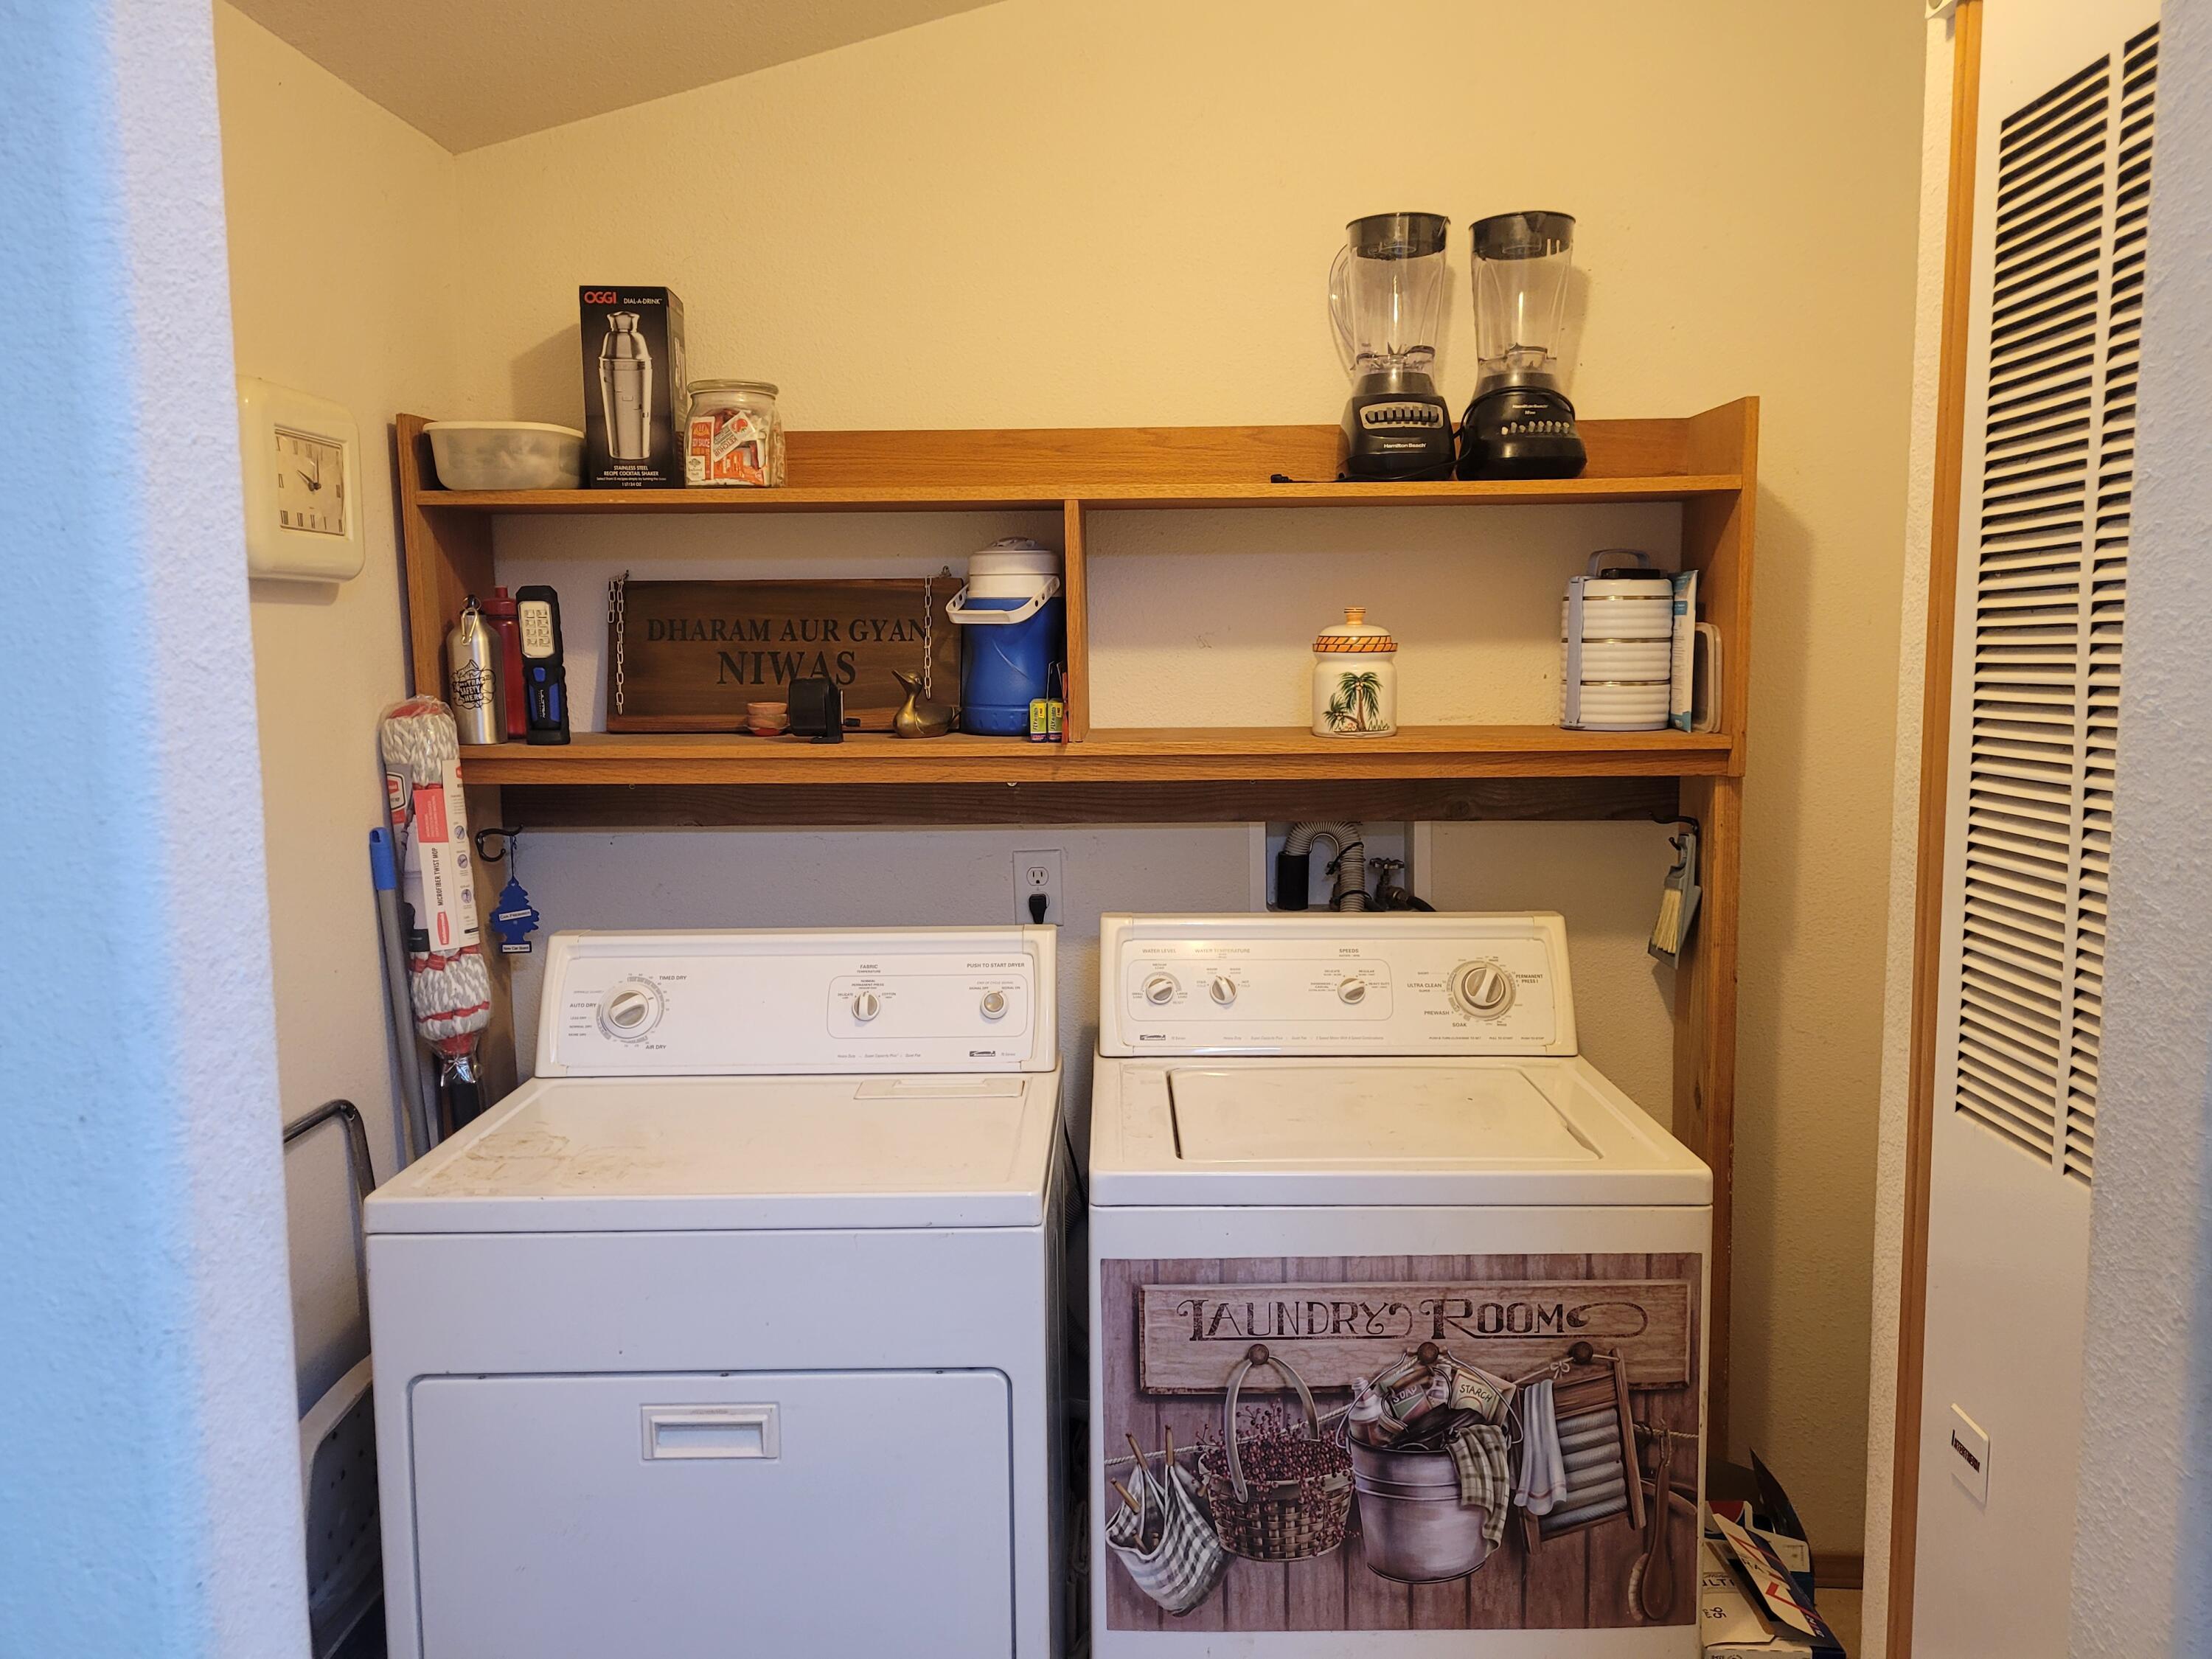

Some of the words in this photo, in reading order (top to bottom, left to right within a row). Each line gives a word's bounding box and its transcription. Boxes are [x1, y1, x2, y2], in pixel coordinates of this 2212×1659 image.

[584, 291, 616, 304] OGGI
[647, 619, 771, 641] DHARAM
[779, 619, 840, 641] AUR
[849, 619, 927, 641] GYAN
[717, 650, 856, 685] NIWAS
[465, 693, 484, 702] HERO
[433, 861, 441, 875] TWIST
[434, 876, 443, 906] MICROFIBER
[1177, 1298, 1413, 1341] LAUNDRY
[1419, 1298, 1585, 1340] ROOM
[1393, 1385, 1418, 1403] SOAP
[1459, 1384, 1492, 1402] STARCH
[1709, 1607, 1727, 1618] 95
